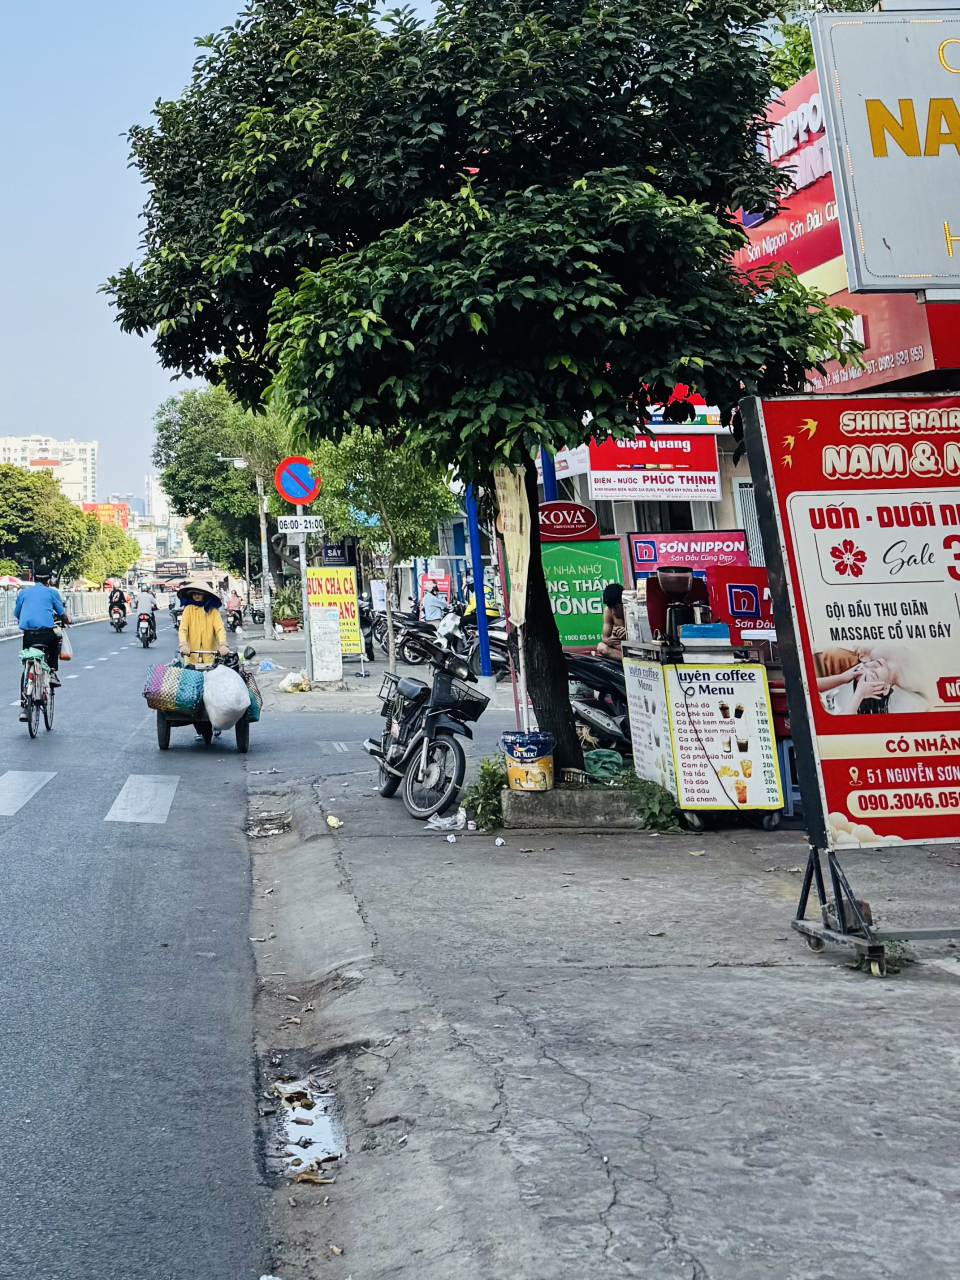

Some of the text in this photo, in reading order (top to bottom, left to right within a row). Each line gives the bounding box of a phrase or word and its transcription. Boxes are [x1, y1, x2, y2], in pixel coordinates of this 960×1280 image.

[769, 93, 825, 162] NIPPO
[762, 231, 788, 256] Nippon
[790, 220, 804, 241] Sơn
[840, 408, 960, 436] SHINE HAIR
[650, 440, 691, 452] quang
[822, 441, 943, 479] NAM &
[594, 476, 612, 486] ĐIỆN
[642, 473, 675, 485] PHÚC
[678, 476, 716, 488] THỊNH
[279, 520, 299, 530] 06:00
[304, 519, 323, 529] 21:00
[538, 510, 586, 525] KOVA
[659, 541, 745, 553] SƠN NIPPON
[670, 554, 683, 562] Sơn
[719, 554, 734, 564] Đẹp
[883, 540, 936, 575] Sale
[554, 564, 602, 575] NHÀ NHỚ
[307, 572, 323, 595] BÚN
[344, 572, 355, 595] CÁ
[826, 600, 929, 621] GỘI ĐẦU THƯ GIÃN
[735, 620, 754, 629] Sơn
[830, 620, 952, 641] MASSAGE CỔ VAI GÁY
[716, 670, 756, 682] coffee
[698, 684, 734, 696] Menu
[886, 734, 960, 755] CÓ NHẬN
[867, 768, 883, 784] 51
[886, 762, 934, 783] NGUYỄN
